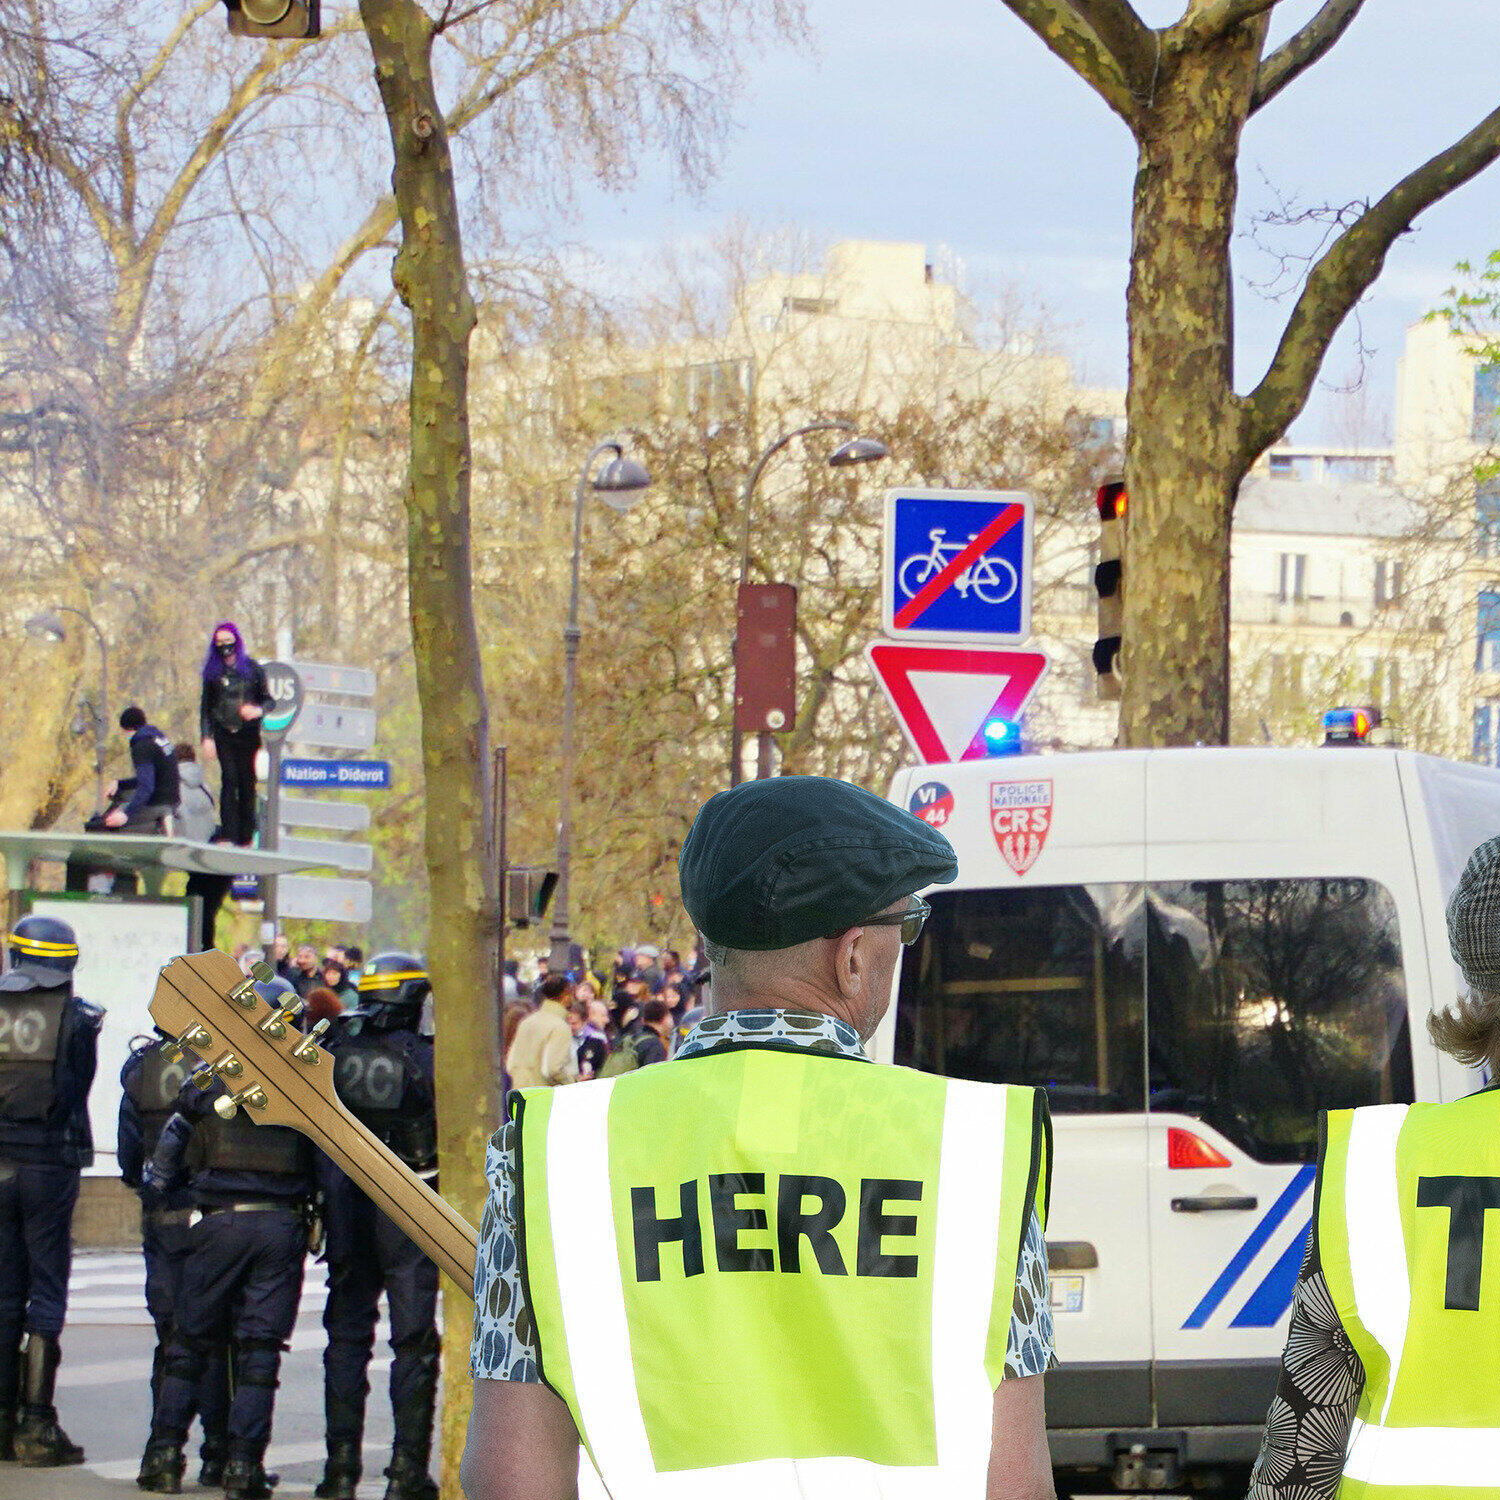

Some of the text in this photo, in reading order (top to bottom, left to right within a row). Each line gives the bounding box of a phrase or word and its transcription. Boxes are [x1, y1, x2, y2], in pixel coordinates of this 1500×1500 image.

[263, 678, 296, 701] US
[285, 766, 327, 781] Nation
[338, 768, 384, 782] Diderot
[917, 786, 937, 804] VI
[1000, 784, 1045, 796] POLICE
[994, 796, 1048, 806] NATIONALE
[925, 808, 947, 824] 44
[993, 807, 1048, 834] CRS
[630, 1172, 924, 1283] HERE
